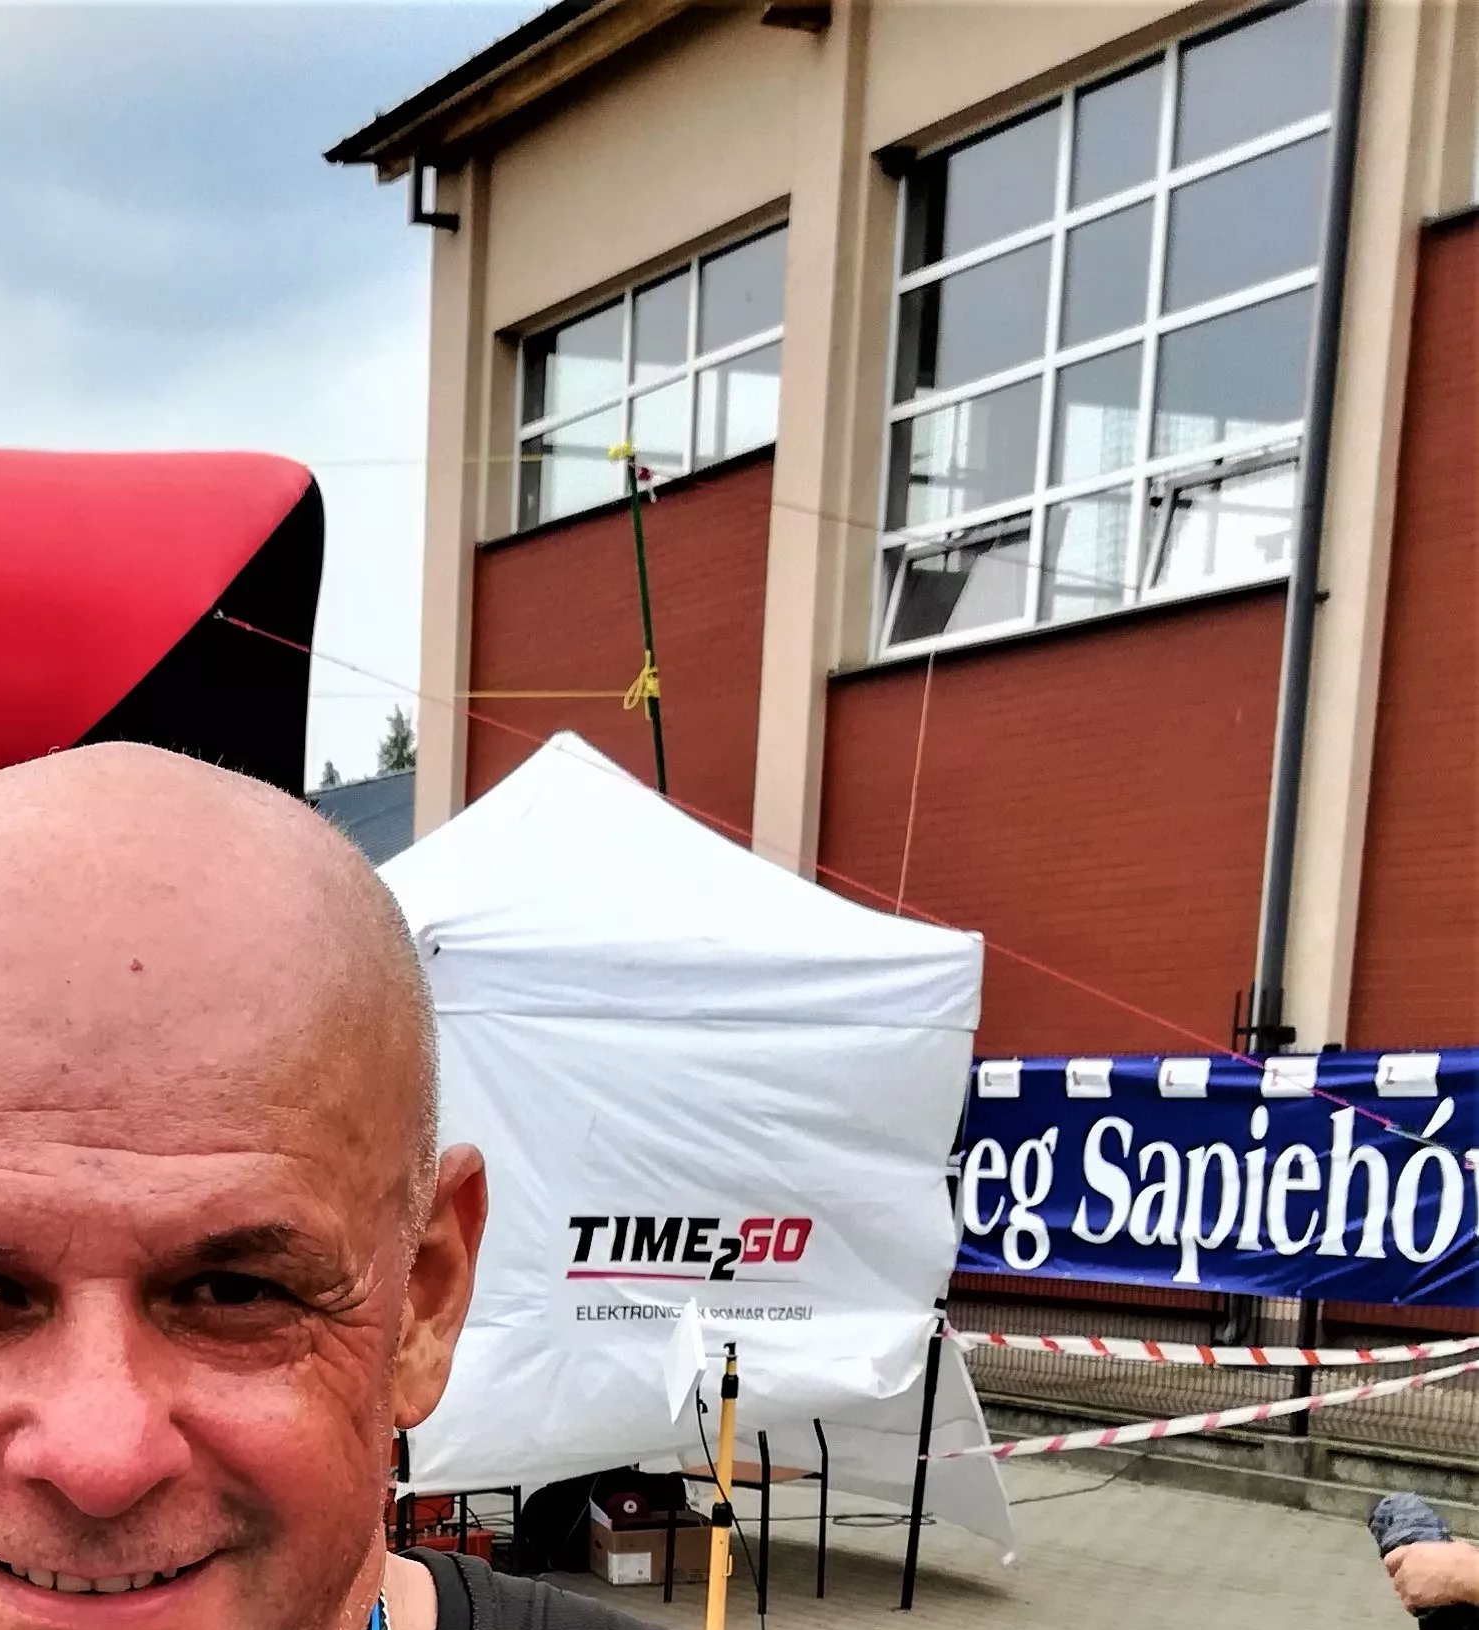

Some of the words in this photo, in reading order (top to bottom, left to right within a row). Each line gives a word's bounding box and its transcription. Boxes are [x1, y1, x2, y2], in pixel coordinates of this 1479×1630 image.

[962, 1126, 1060, 1272] eg
[1071, 1096, 1479, 1284] Sapiehó
[575, 1304, 707, 1322] ELEKTRONICY
[710, 1306, 765, 1321] POMIAR
[767, 1305, 814, 1322] CZASU
